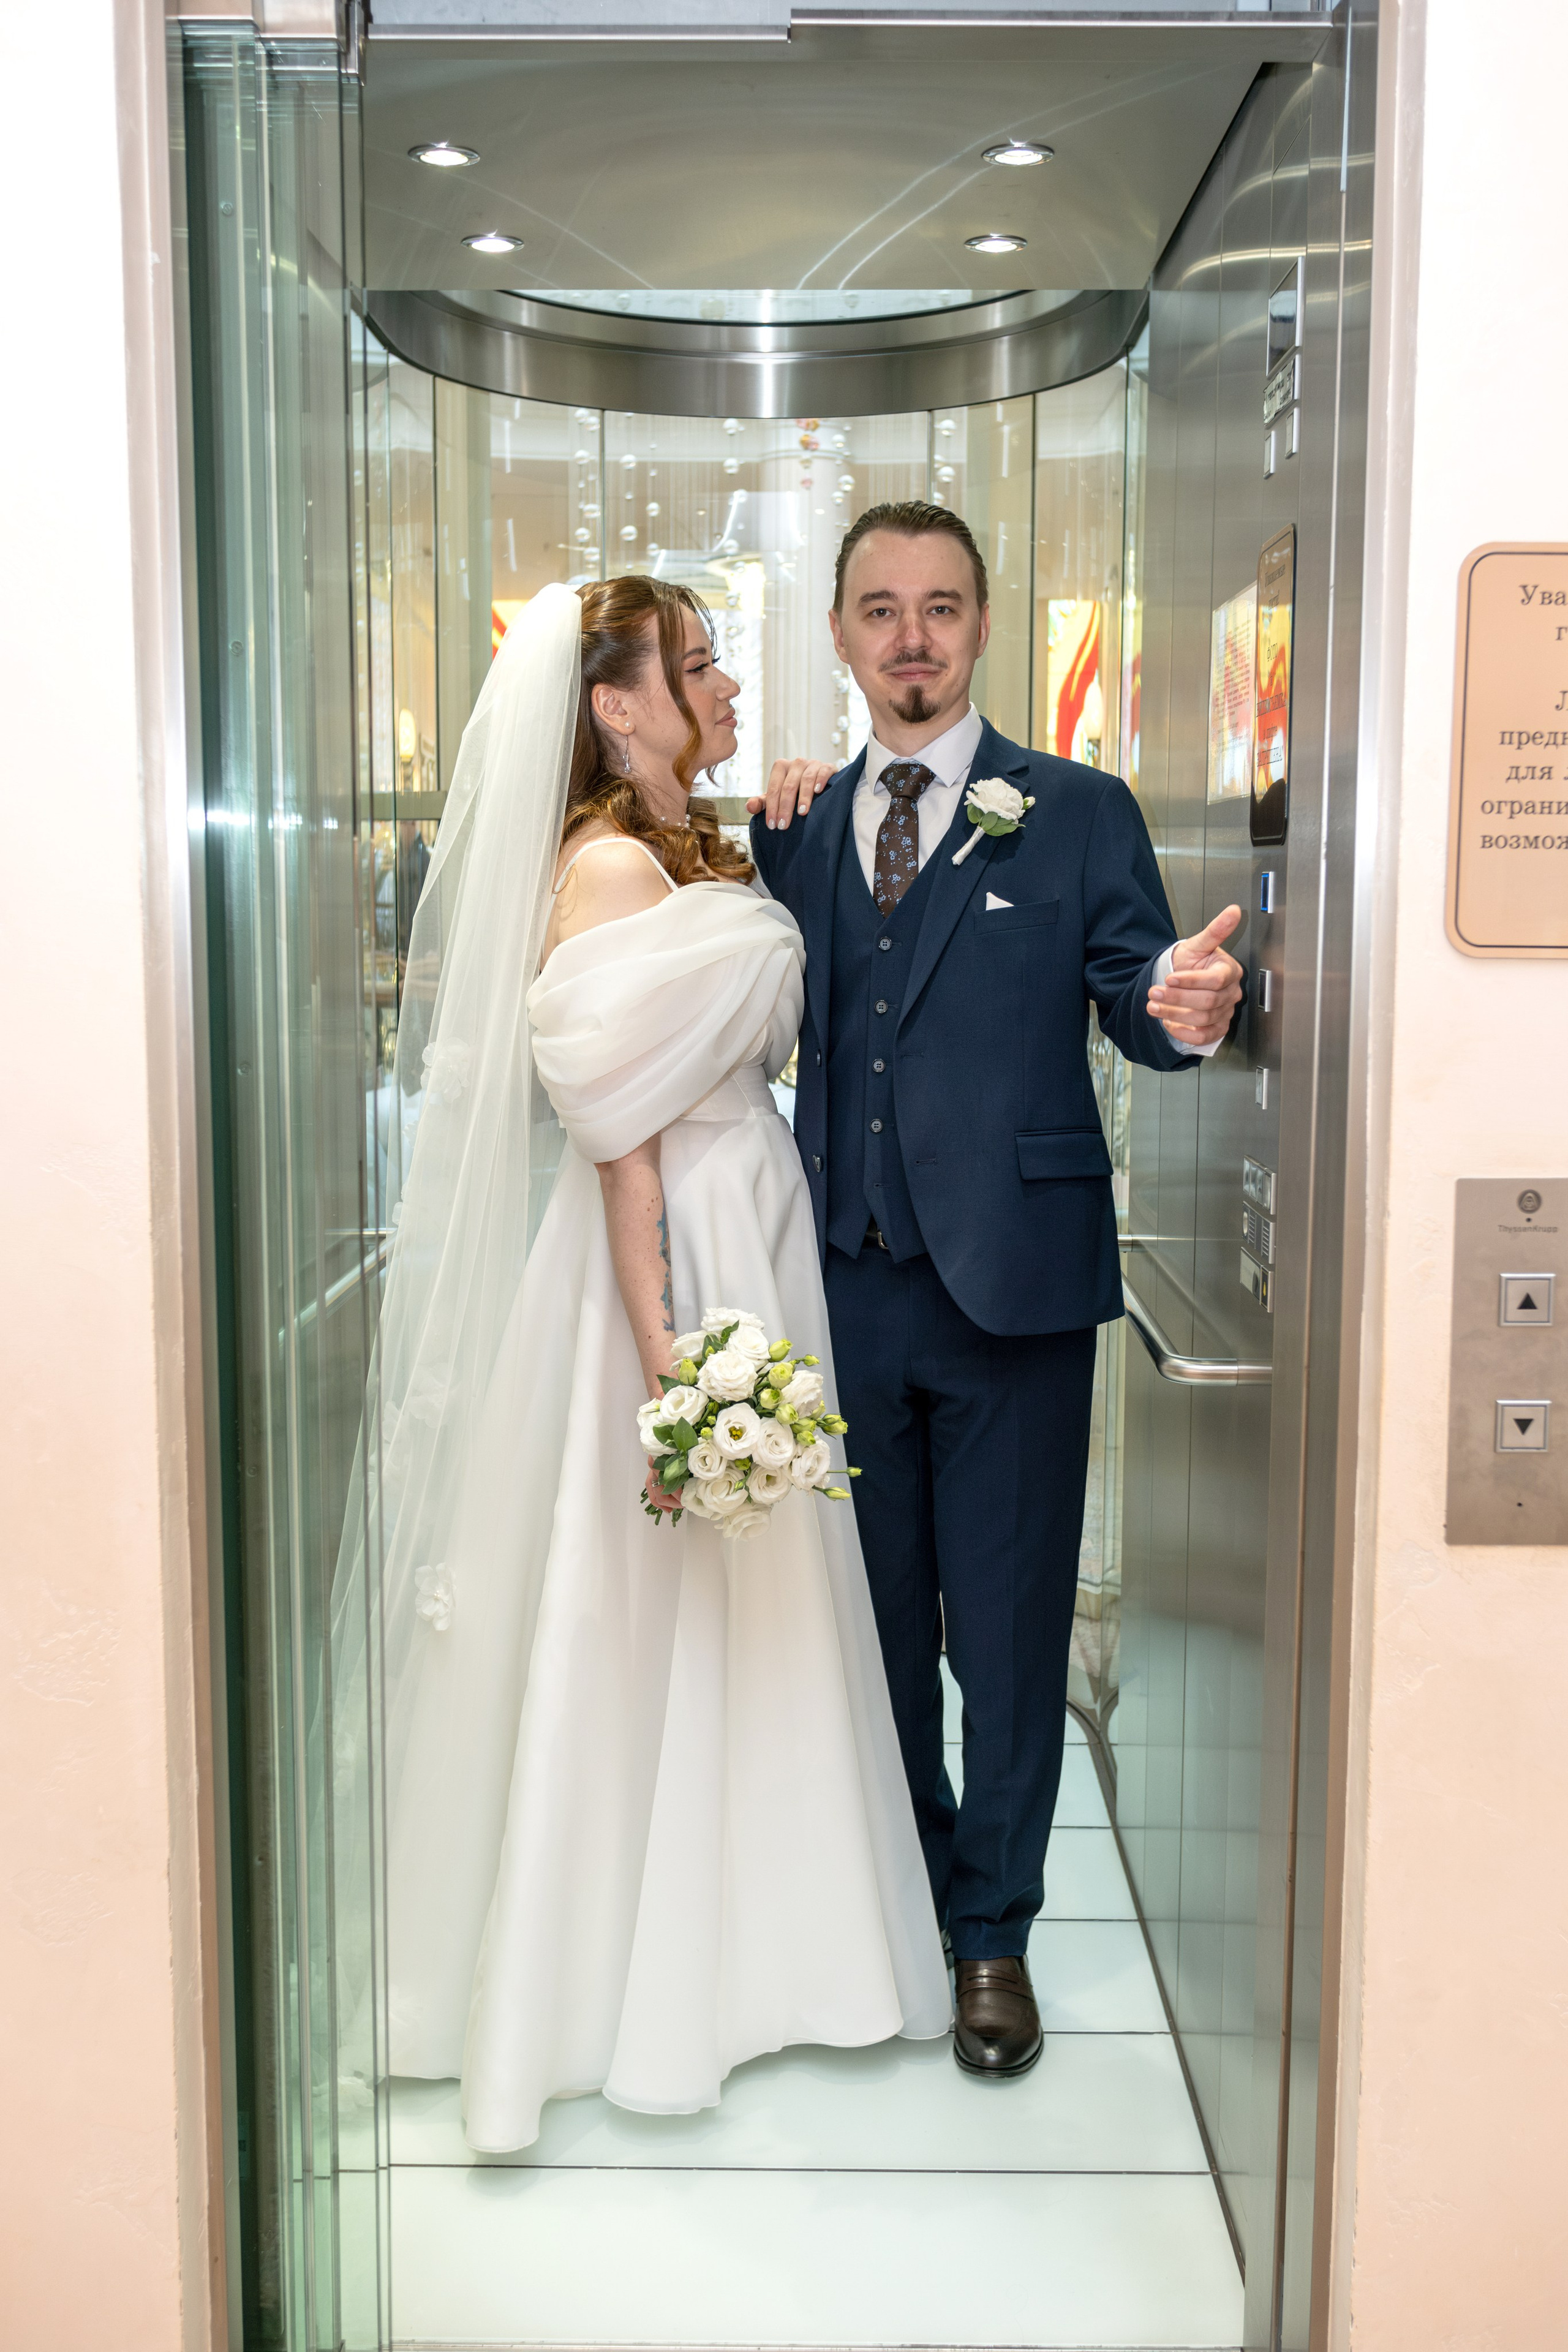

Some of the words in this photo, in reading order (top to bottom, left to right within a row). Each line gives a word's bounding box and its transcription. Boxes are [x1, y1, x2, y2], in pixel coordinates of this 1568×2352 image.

[1518, 584, 1568, 606] Ува
[1505, 766, 1553, 783] для
[1480, 799, 1568, 819] ограни
